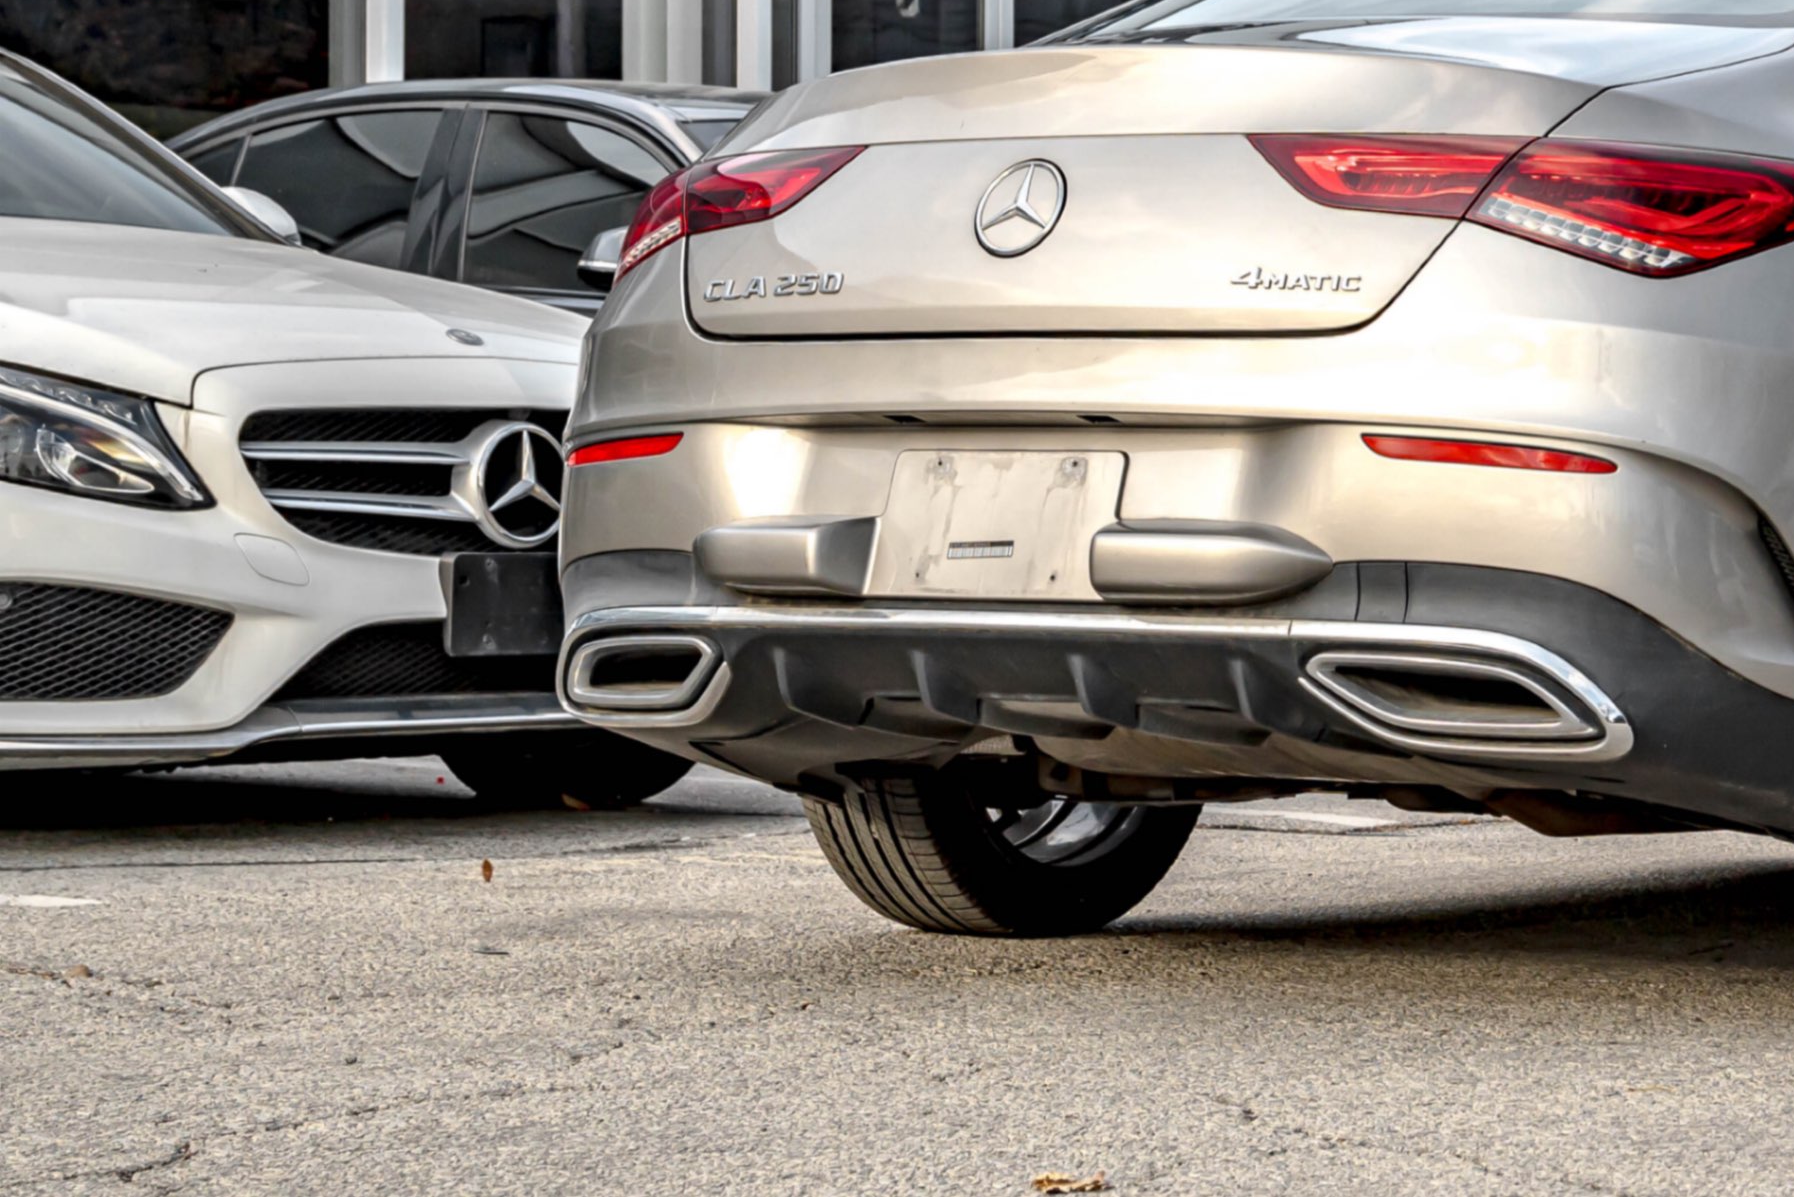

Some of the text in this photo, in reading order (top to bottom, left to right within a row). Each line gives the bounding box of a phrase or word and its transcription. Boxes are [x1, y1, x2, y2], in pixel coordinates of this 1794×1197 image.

[704, 272, 844, 302] CLA 250
[1230, 267, 1362, 292] 4MATIC
